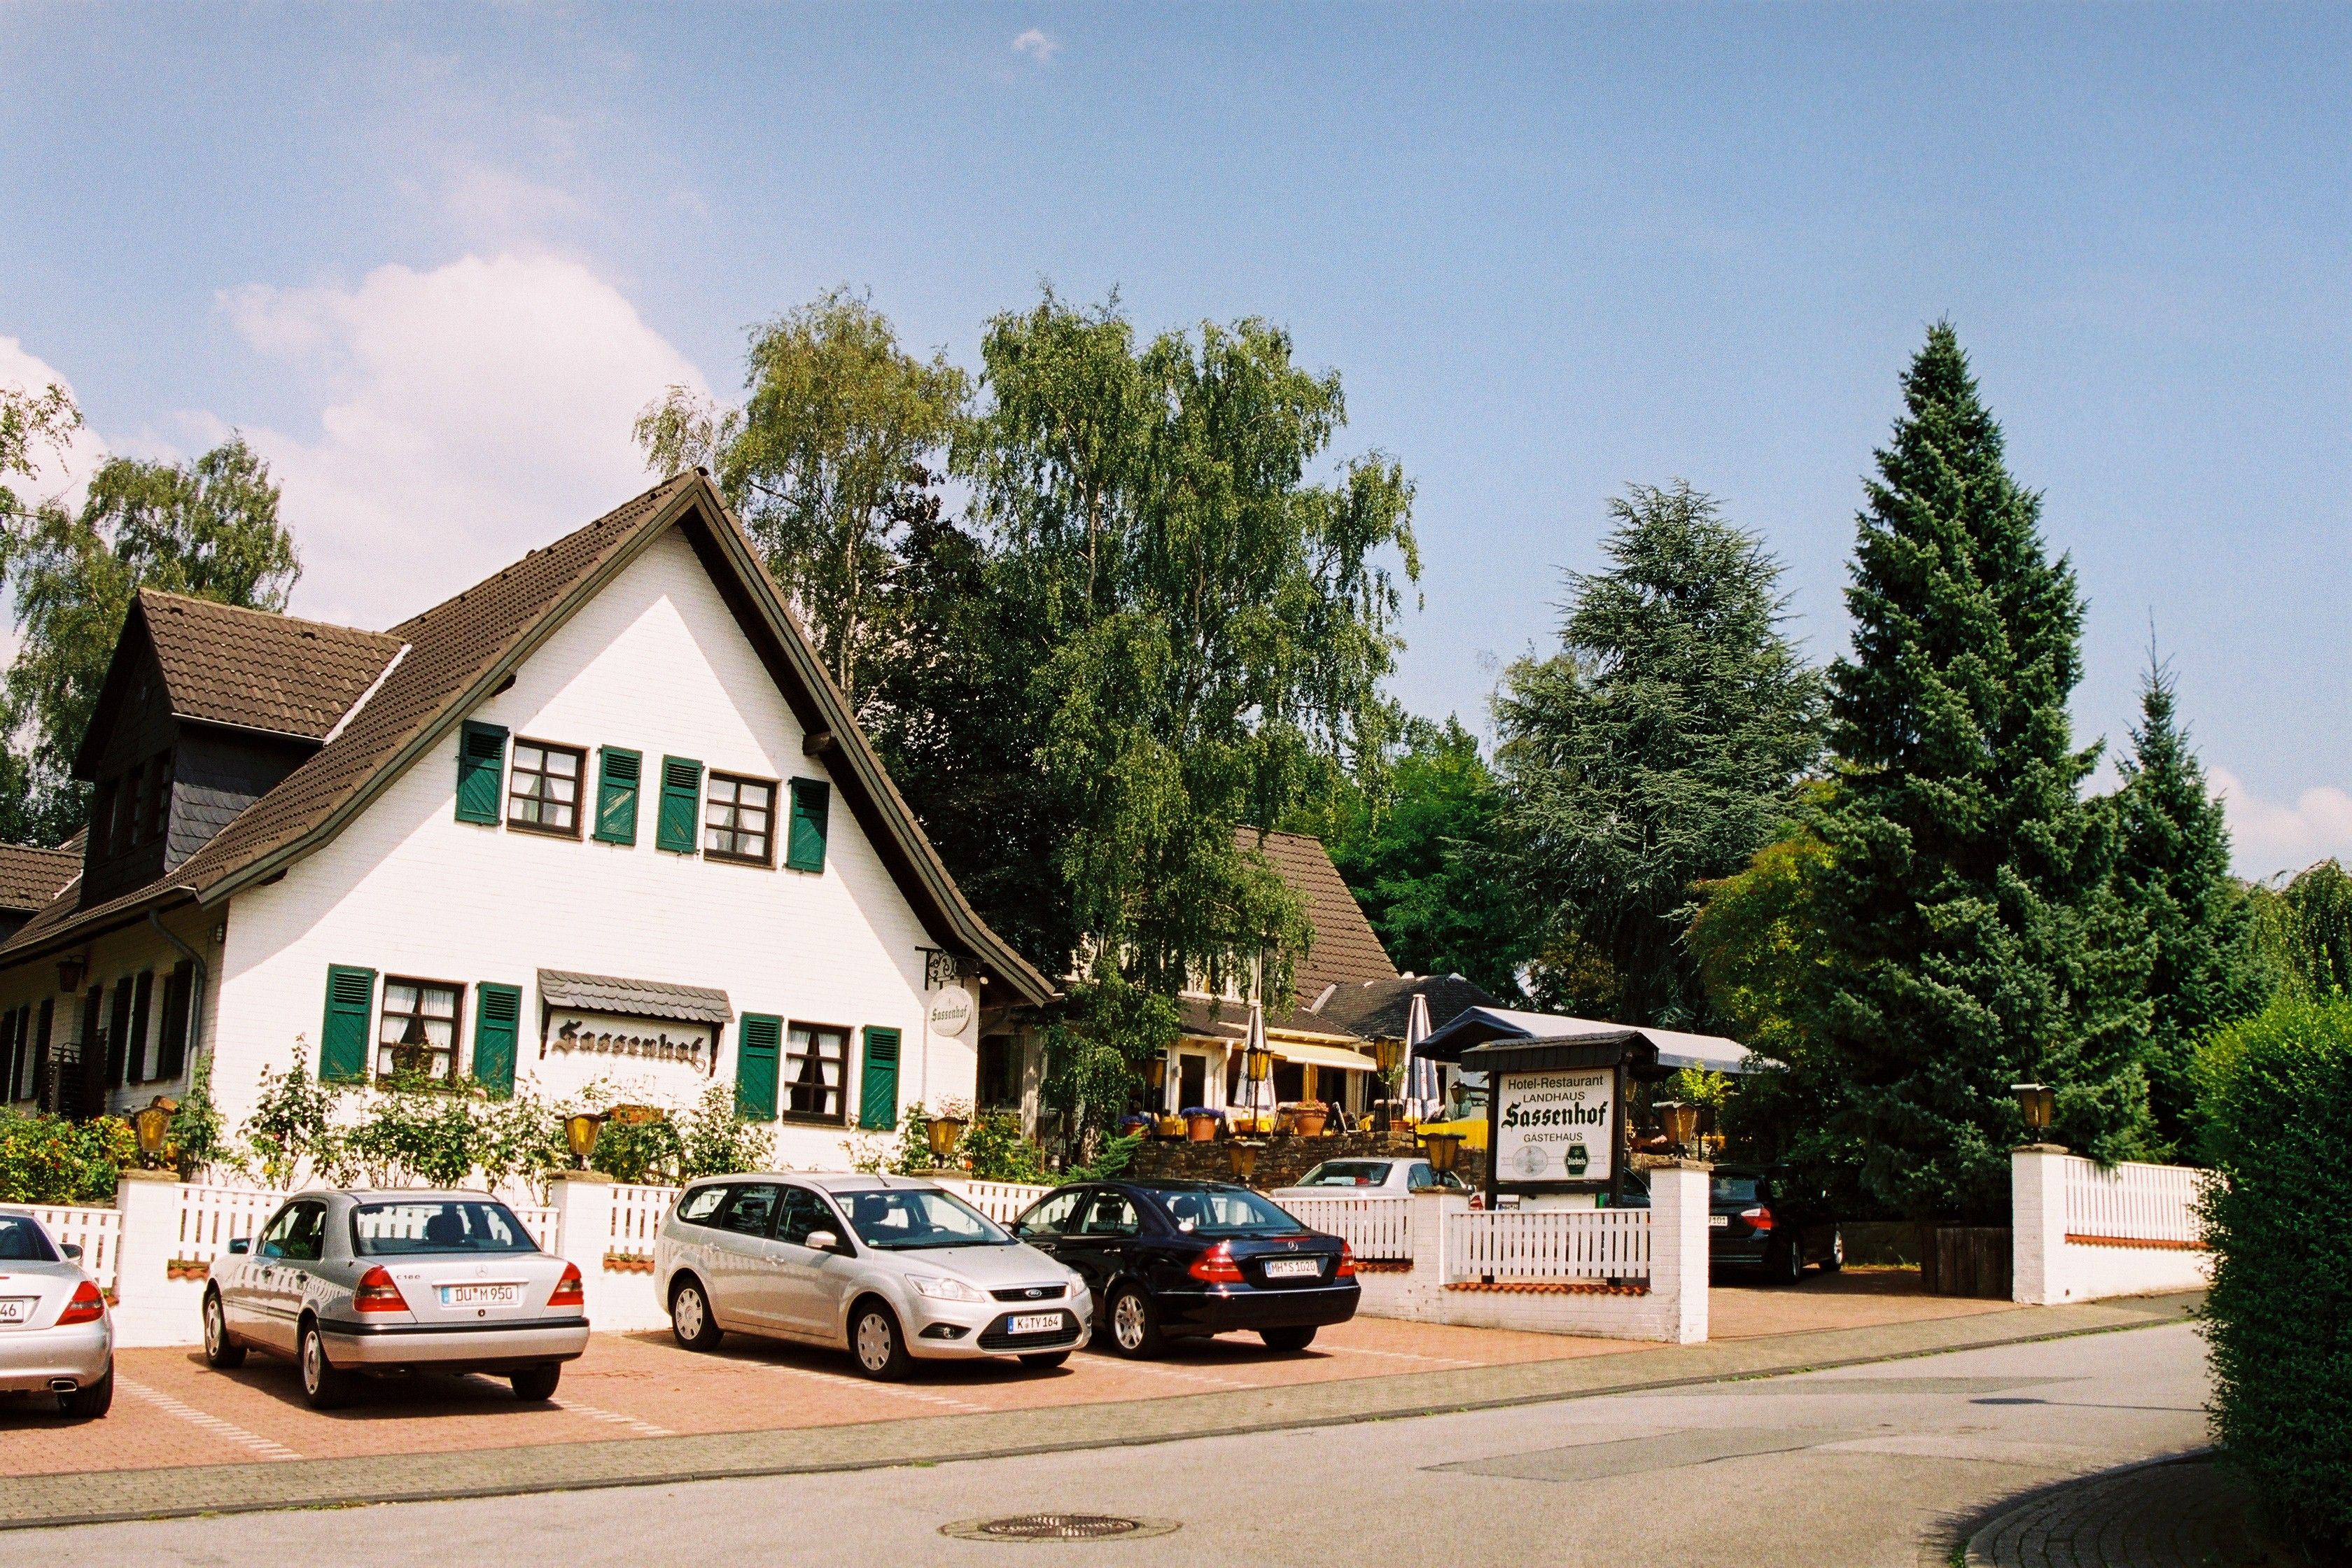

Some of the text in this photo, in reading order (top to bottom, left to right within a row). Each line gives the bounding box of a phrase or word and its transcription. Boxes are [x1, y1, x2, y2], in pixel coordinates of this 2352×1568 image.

[551, 1019, 706, 1073] Sassenhof
[1508, 1074, 1604, 1090] Hotel-Restaurant
[1523, 1091, 1586, 1103] LANDHAUS
[1501, 1100, 1609, 1133] Sassenhof
[456, 1287, 512, 1302] DU M 950
[1017, 1315, 1058, 1329] K TY 164
